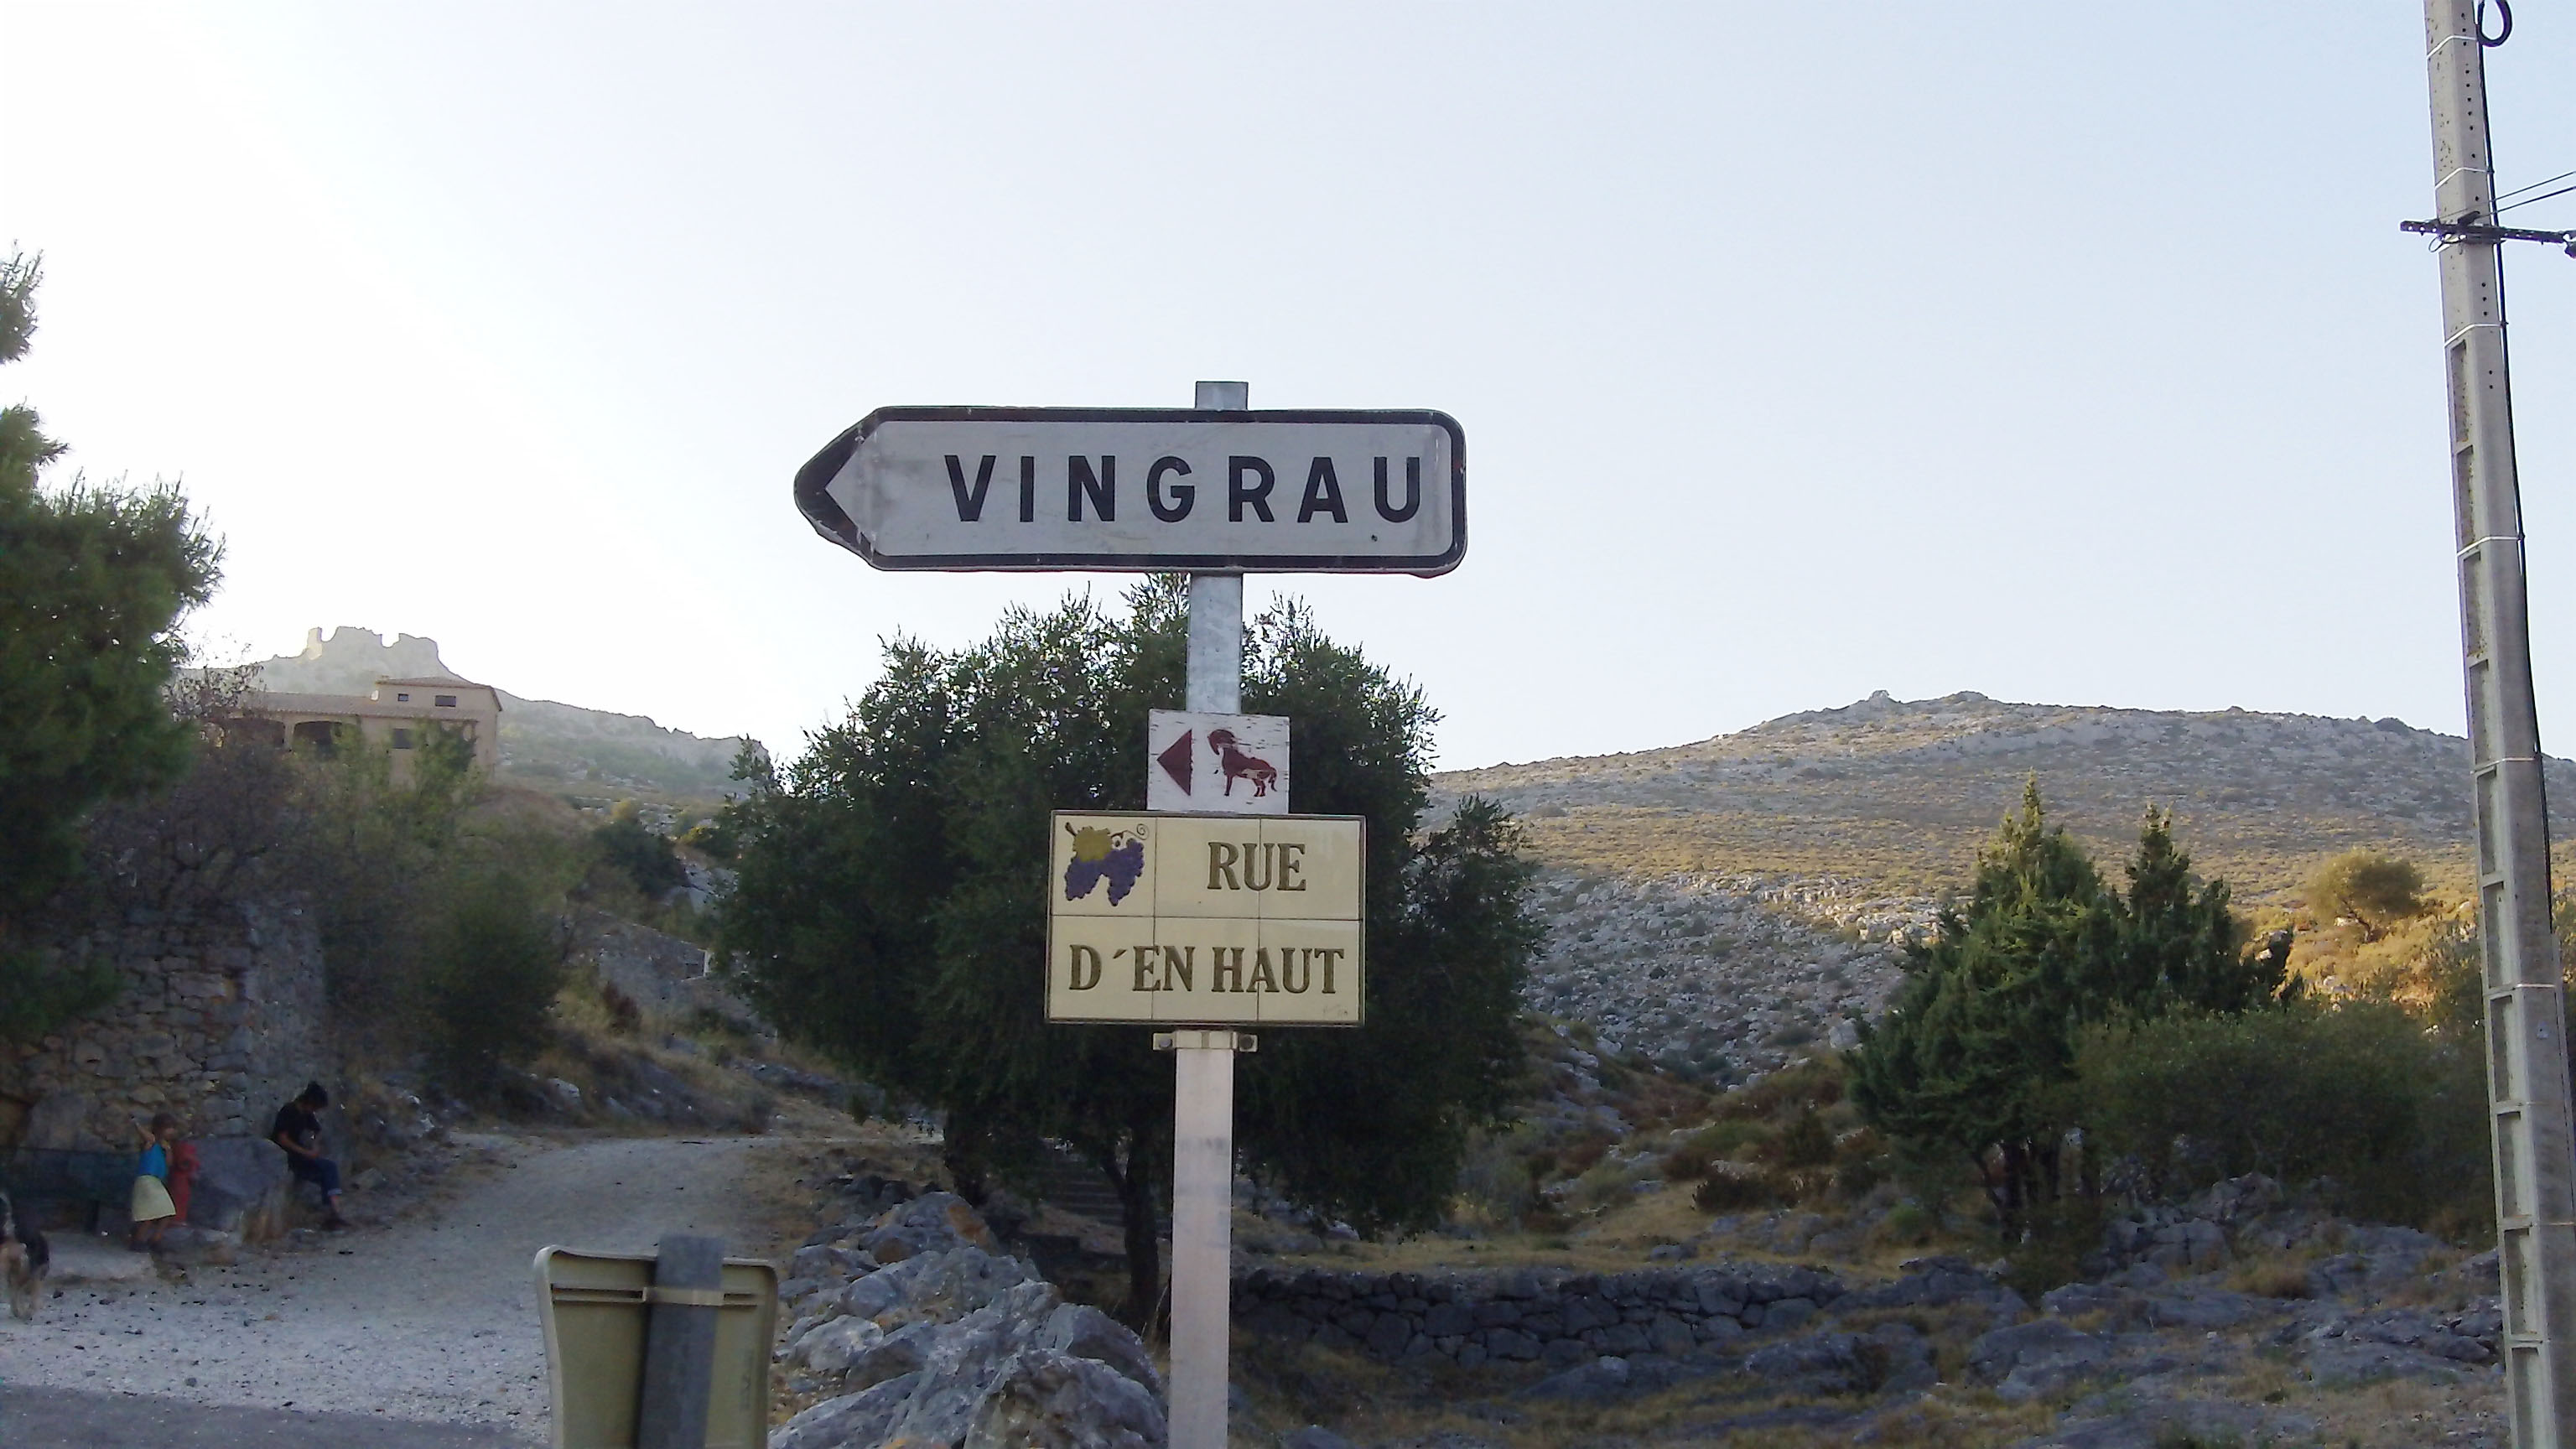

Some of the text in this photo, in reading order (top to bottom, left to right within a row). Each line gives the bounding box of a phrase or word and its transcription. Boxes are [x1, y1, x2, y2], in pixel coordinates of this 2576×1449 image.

[944, 455, 1420, 522] VINGRAU
[1207, 841, 1306, 891] RUE
[1211, 946, 1345, 995] HAUT
